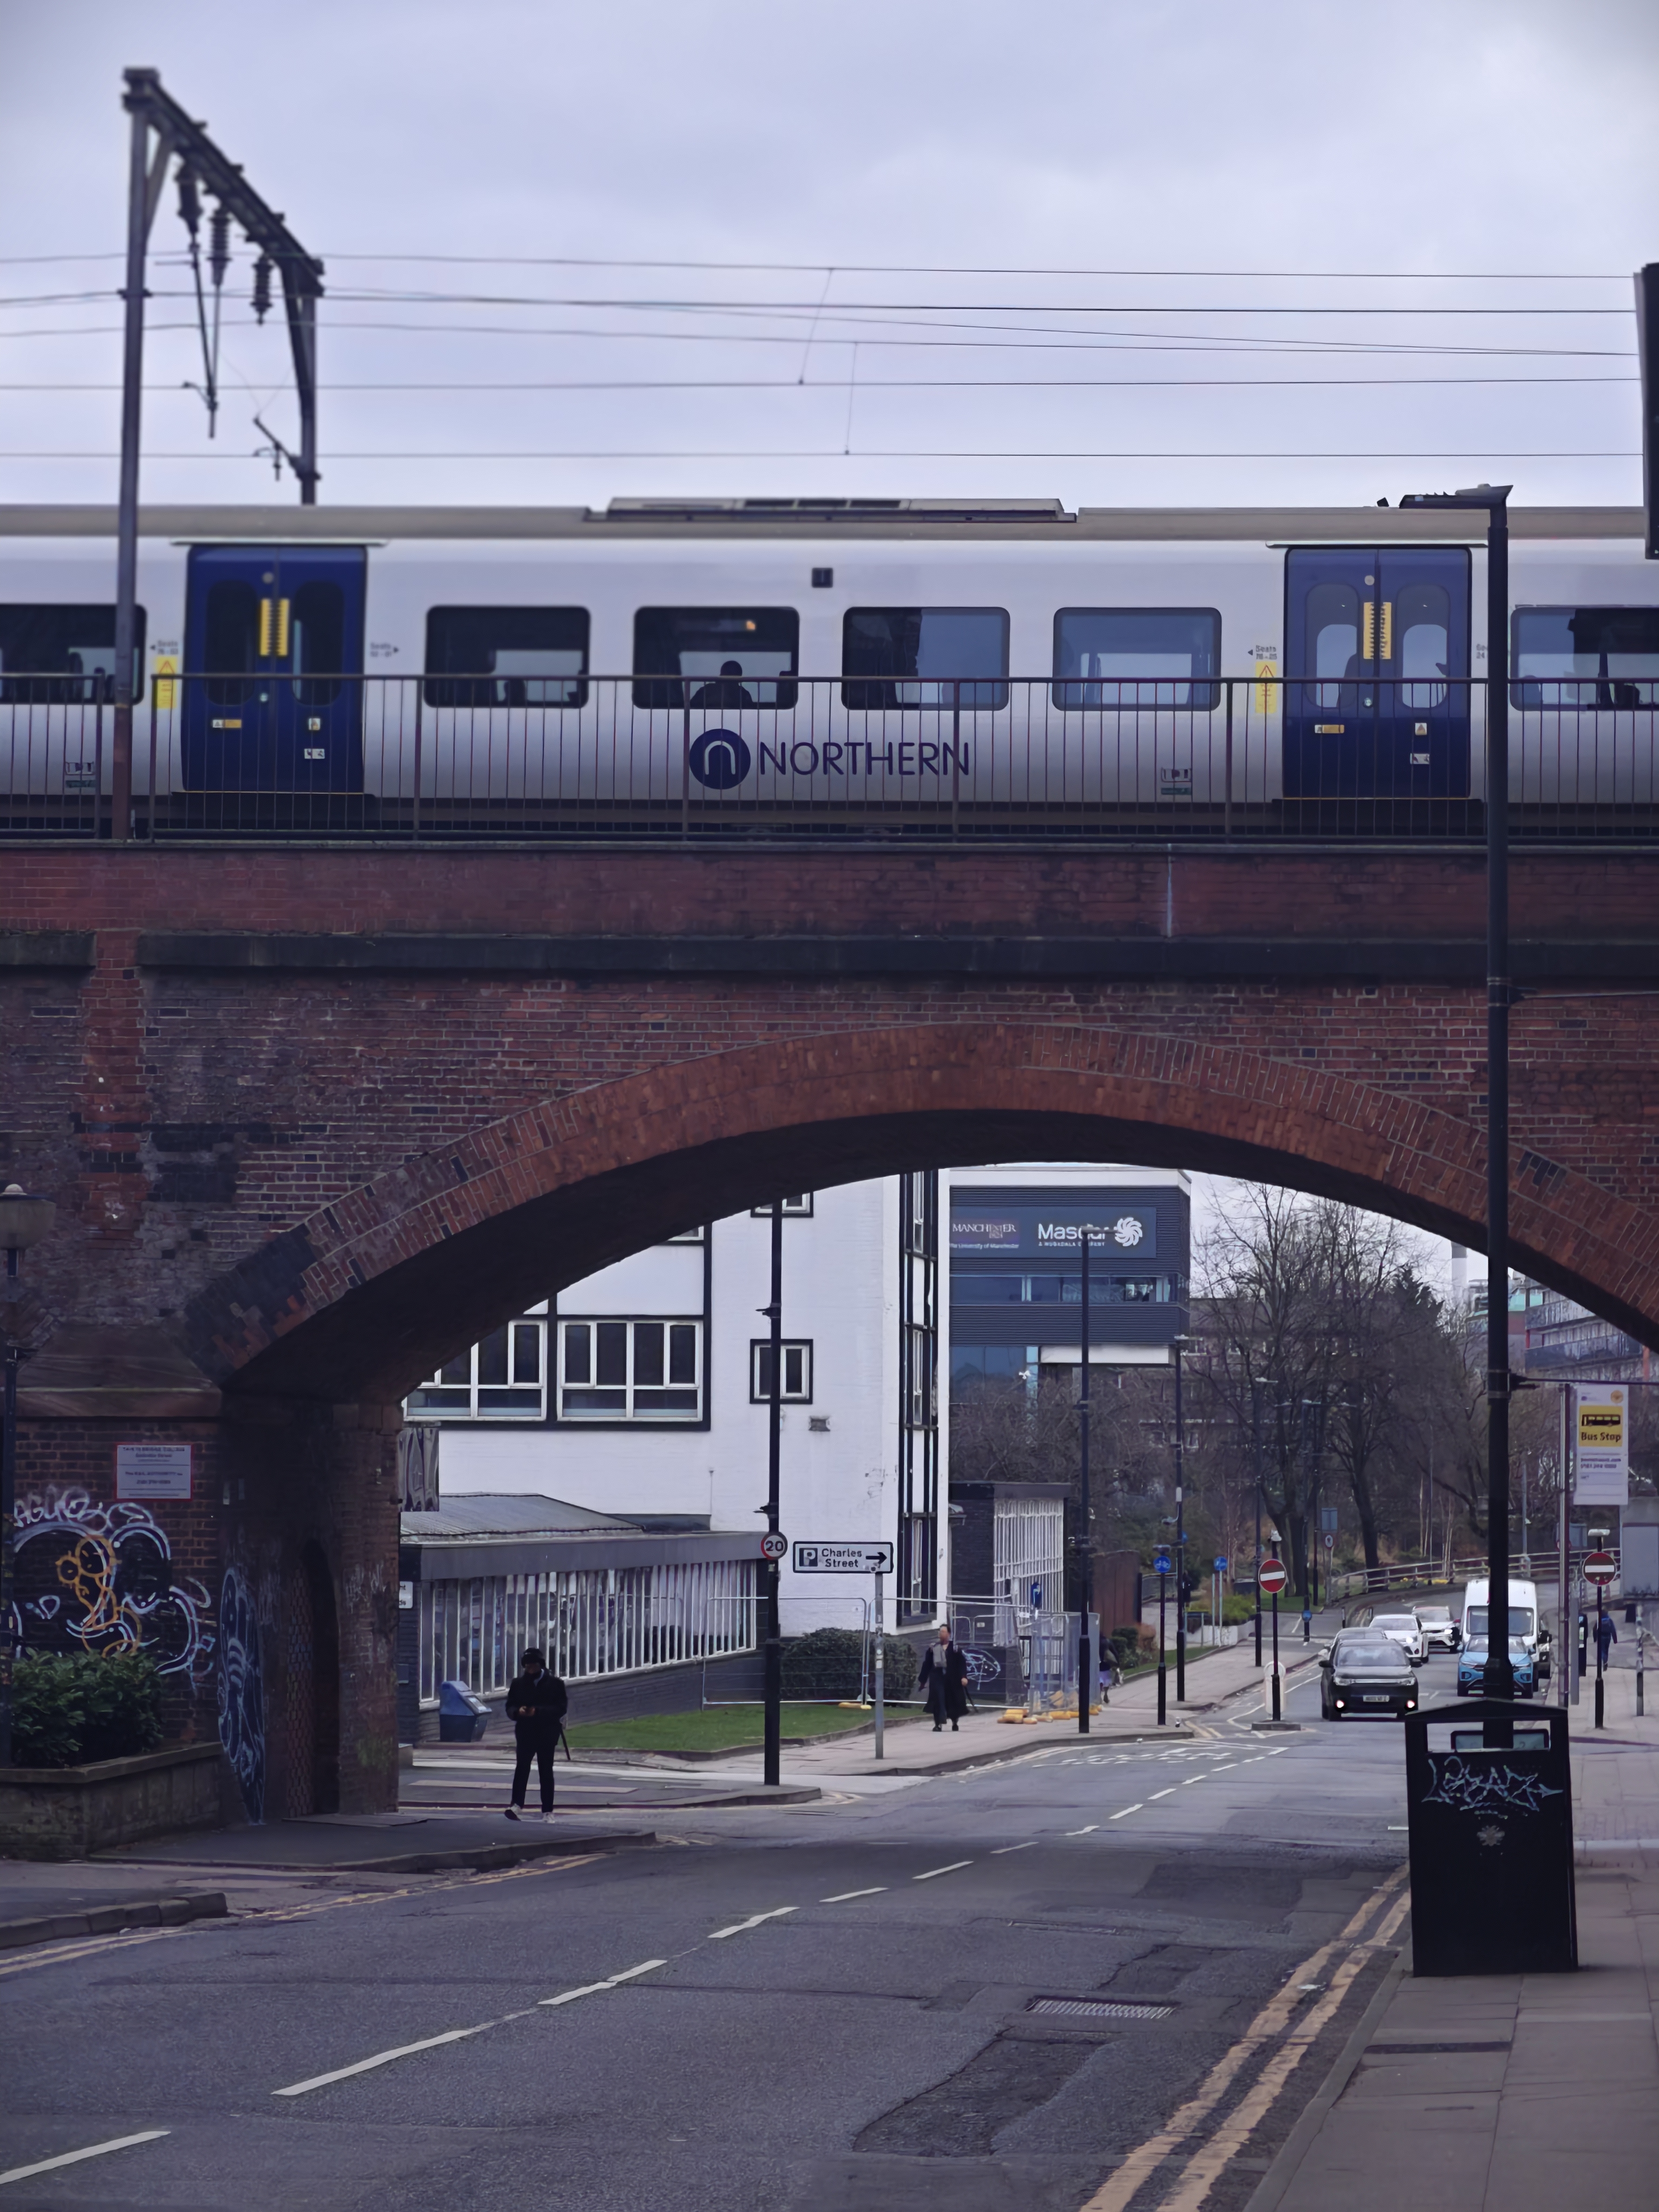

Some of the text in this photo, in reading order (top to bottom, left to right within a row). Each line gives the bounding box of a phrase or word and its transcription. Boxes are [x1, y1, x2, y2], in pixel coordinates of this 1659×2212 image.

[759, 741, 969, 776] NORTHERN
[1581, 1432, 1621, 1442] Bus Stop
[765, 1540, 784, 1552] 20
[821, 1548, 862, 1557] Charles
[825, 1559, 859, 1568] Street
